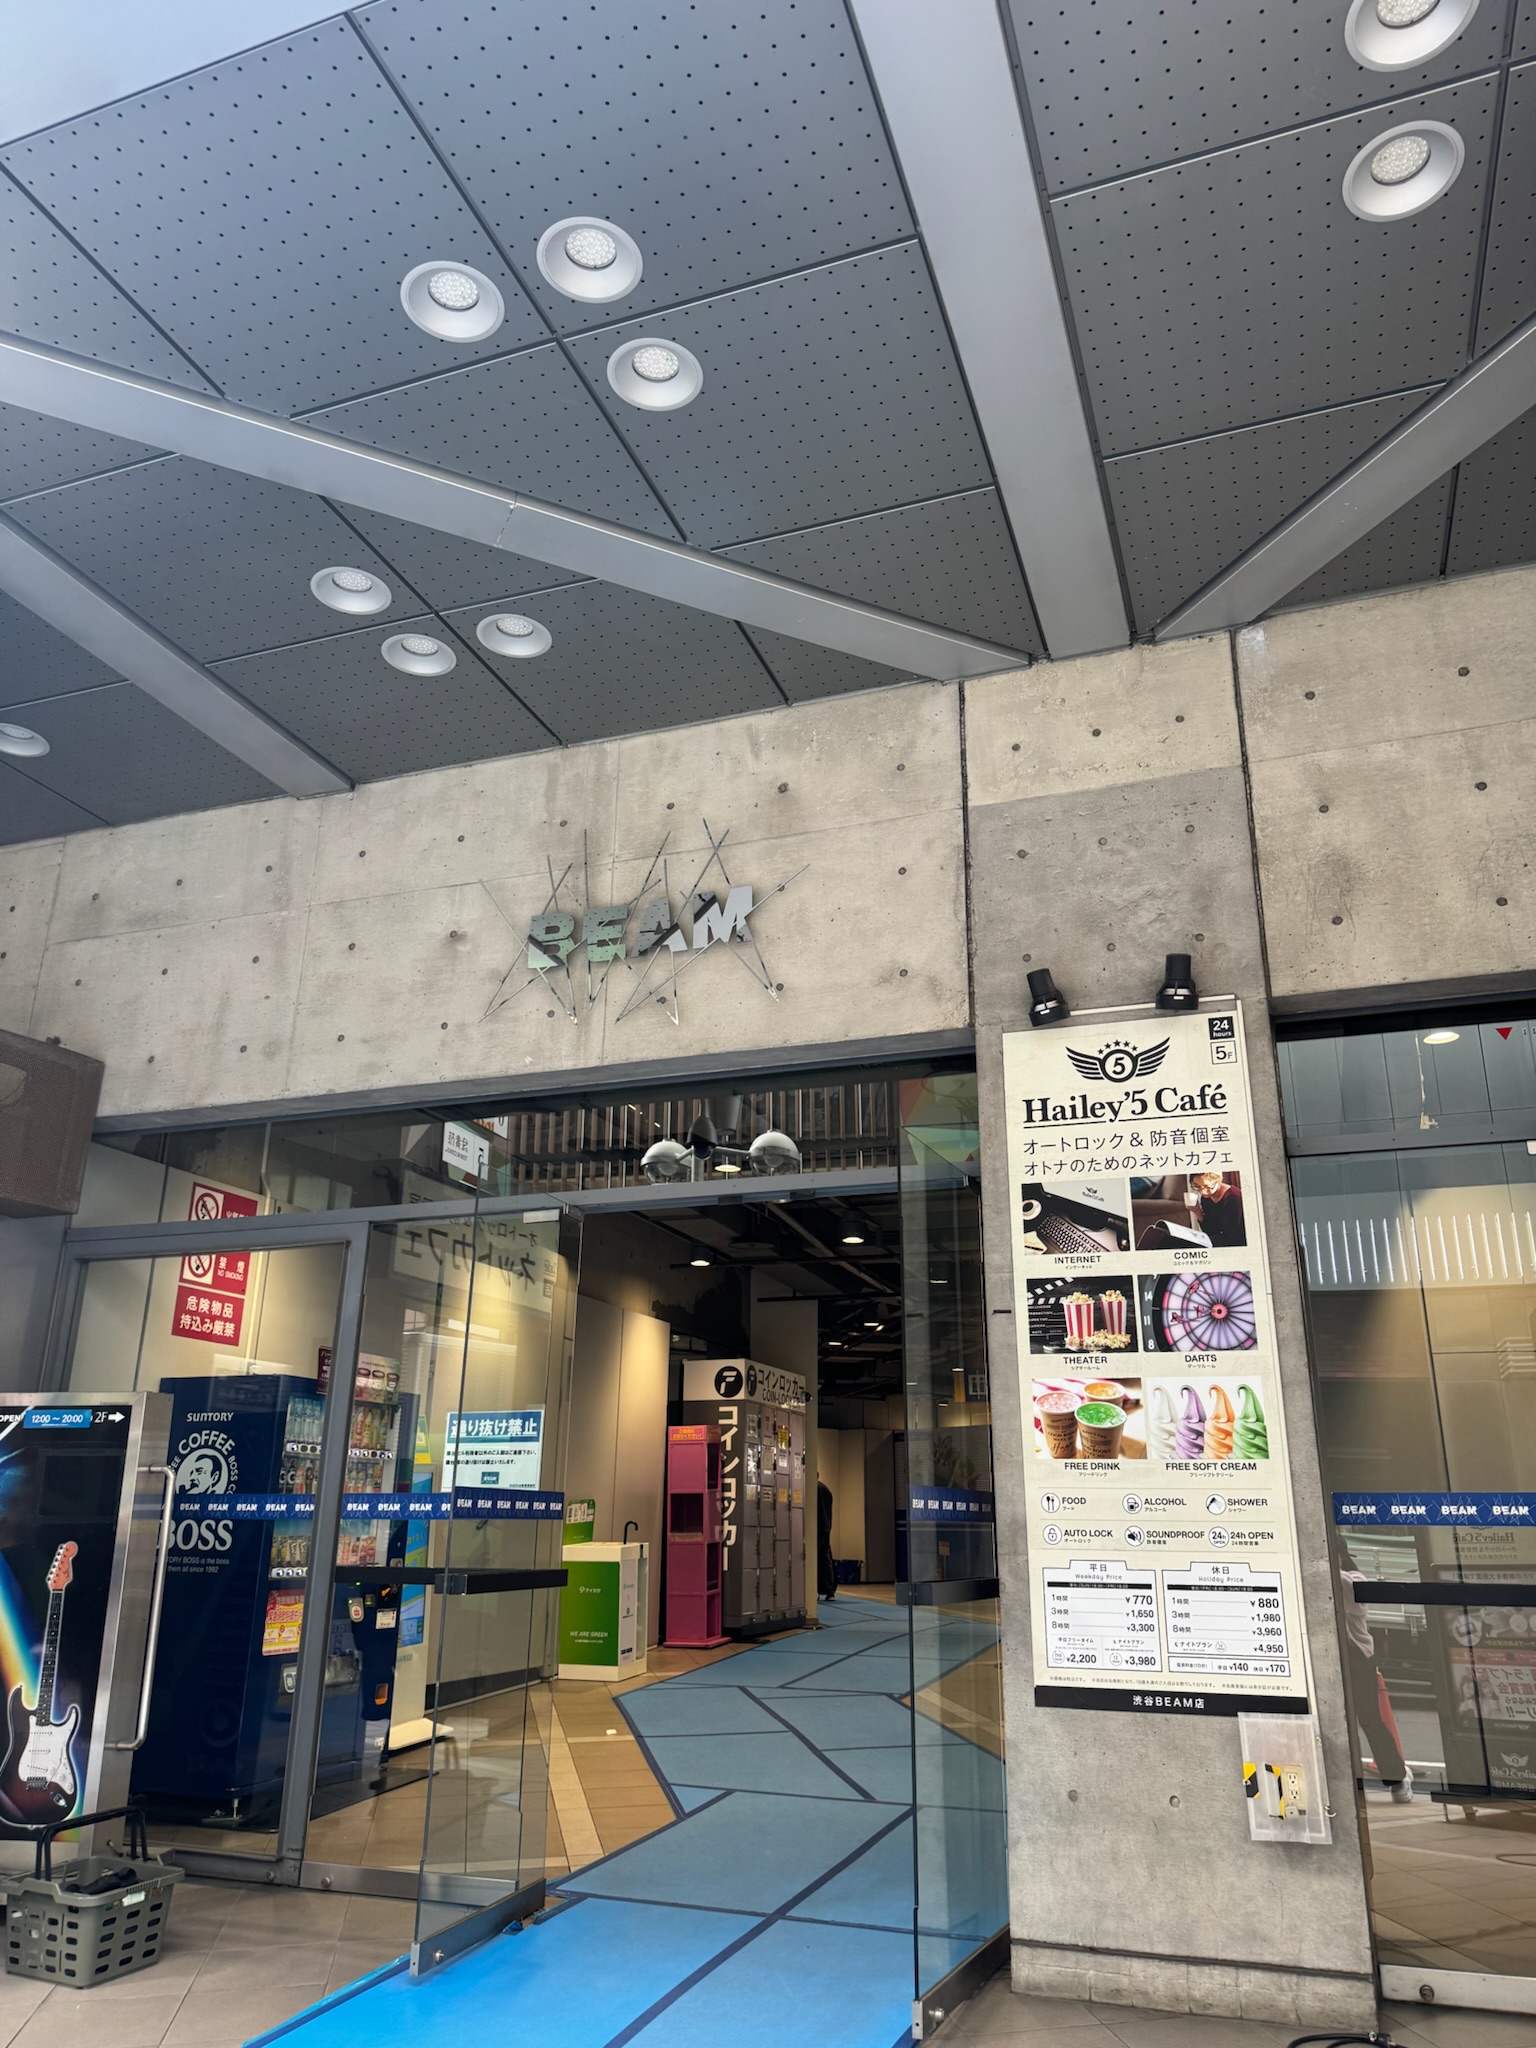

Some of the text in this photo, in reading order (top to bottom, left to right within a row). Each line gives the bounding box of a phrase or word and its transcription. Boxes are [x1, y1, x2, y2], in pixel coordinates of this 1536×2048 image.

[527, 885, 753, 969] BEAM
[1212, 1020, 1229, 1031] 24
[1216, 1046, 1233, 1060] 5F
[1112, 1057, 1126, 1076] 5
[1155, 1083, 1227, 1113] Café
[1023, 1150, 1233, 1176] オトナのためのネットカフェ
[1055, 1256, 1101, 1265] INTERNET
[1174, 1251, 1208, 1260] COMIC
[185, 1295, 234, 1318] 危険物品
[179, 1314, 236, 1338] 持込み厳禁
[1063, 1356, 1108, 1365] THEATER
[1185, 1354, 1217, 1363] DARTS
[758, 1369, 805, 1396] コインロッカー
[31, 1415, 50, 1423] 12:00
[61, 1414, 83, 1423] 20:00
[94, 1411, 108, 1423] 2F
[186, 1412, 234, 1422] SUNTORY
[178, 1430, 236, 1455] COFFEE
[228, 1456, 239, 1481] BOSS
[1064, 1462, 1120, 1470] FREE DRINK
[1166, 1463, 1257, 1471] FREE SOFT CREAM
[718, 1405, 740, 1571] コインロッカー
[457, 1499, 562, 1510] BEAM BEAM BEAM BEAM BEAM BEAM
[912, 1499, 924, 1509] BEAM
[1062, 1496, 1087, 1505] FOOD
[1144, 1498, 1187, 1506] ALCOHOL
[1227, 1498, 1268, 1507] SHOWER
[208, 1503, 229, 1511] BEAM
[236, 1503, 258, 1511] BEAM
[347, 1503, 369, 1511] BEAM
[1342, 1505, 1529, 1516] BEAM BEAM BEAM BEAM
[1064, 1529, 1113, 1538] AUTO LOCK
[1146, 1531, 1206, 1539] SOUNDPROOF
[1230, 1531, 1274, 1540] 24h OPEN
[1089, 1564, 1107, 1572] 平日
[1211, 1566, 1230, 1575] 休日
[1075, 1573, 1104, 1581] Weekday
[1198, 1576, 1225, 1584] Holiday
[1051, 1594, 1153, 1605] 1時間 ¥770
[1172, 1597, 1279, 1608] 1時間 ¥880
[1051, 1607, 1154, 1619] 3時間 ¥1,650
[1172, 1611, 1281, 1623] 3時間 ¥1,980
[1051, 1621, 1155, 1633] 8時間 ¥3,300
[1172, 1625, 1282, 1637] 8時間 ¥3,960
[1253, 1644, 1284, 1654] ¥4,950
[1066, 1654, 1097, 1665] ¥2,200
[1125, 1657, 1156, 1667] ¥3,980
[1229, 1663, 1249, 1672] ¥140
[1265, 1665, 1286, 1673] ¥170
[1132, 1695, 1205, 1709] 渋谷BEAM店
